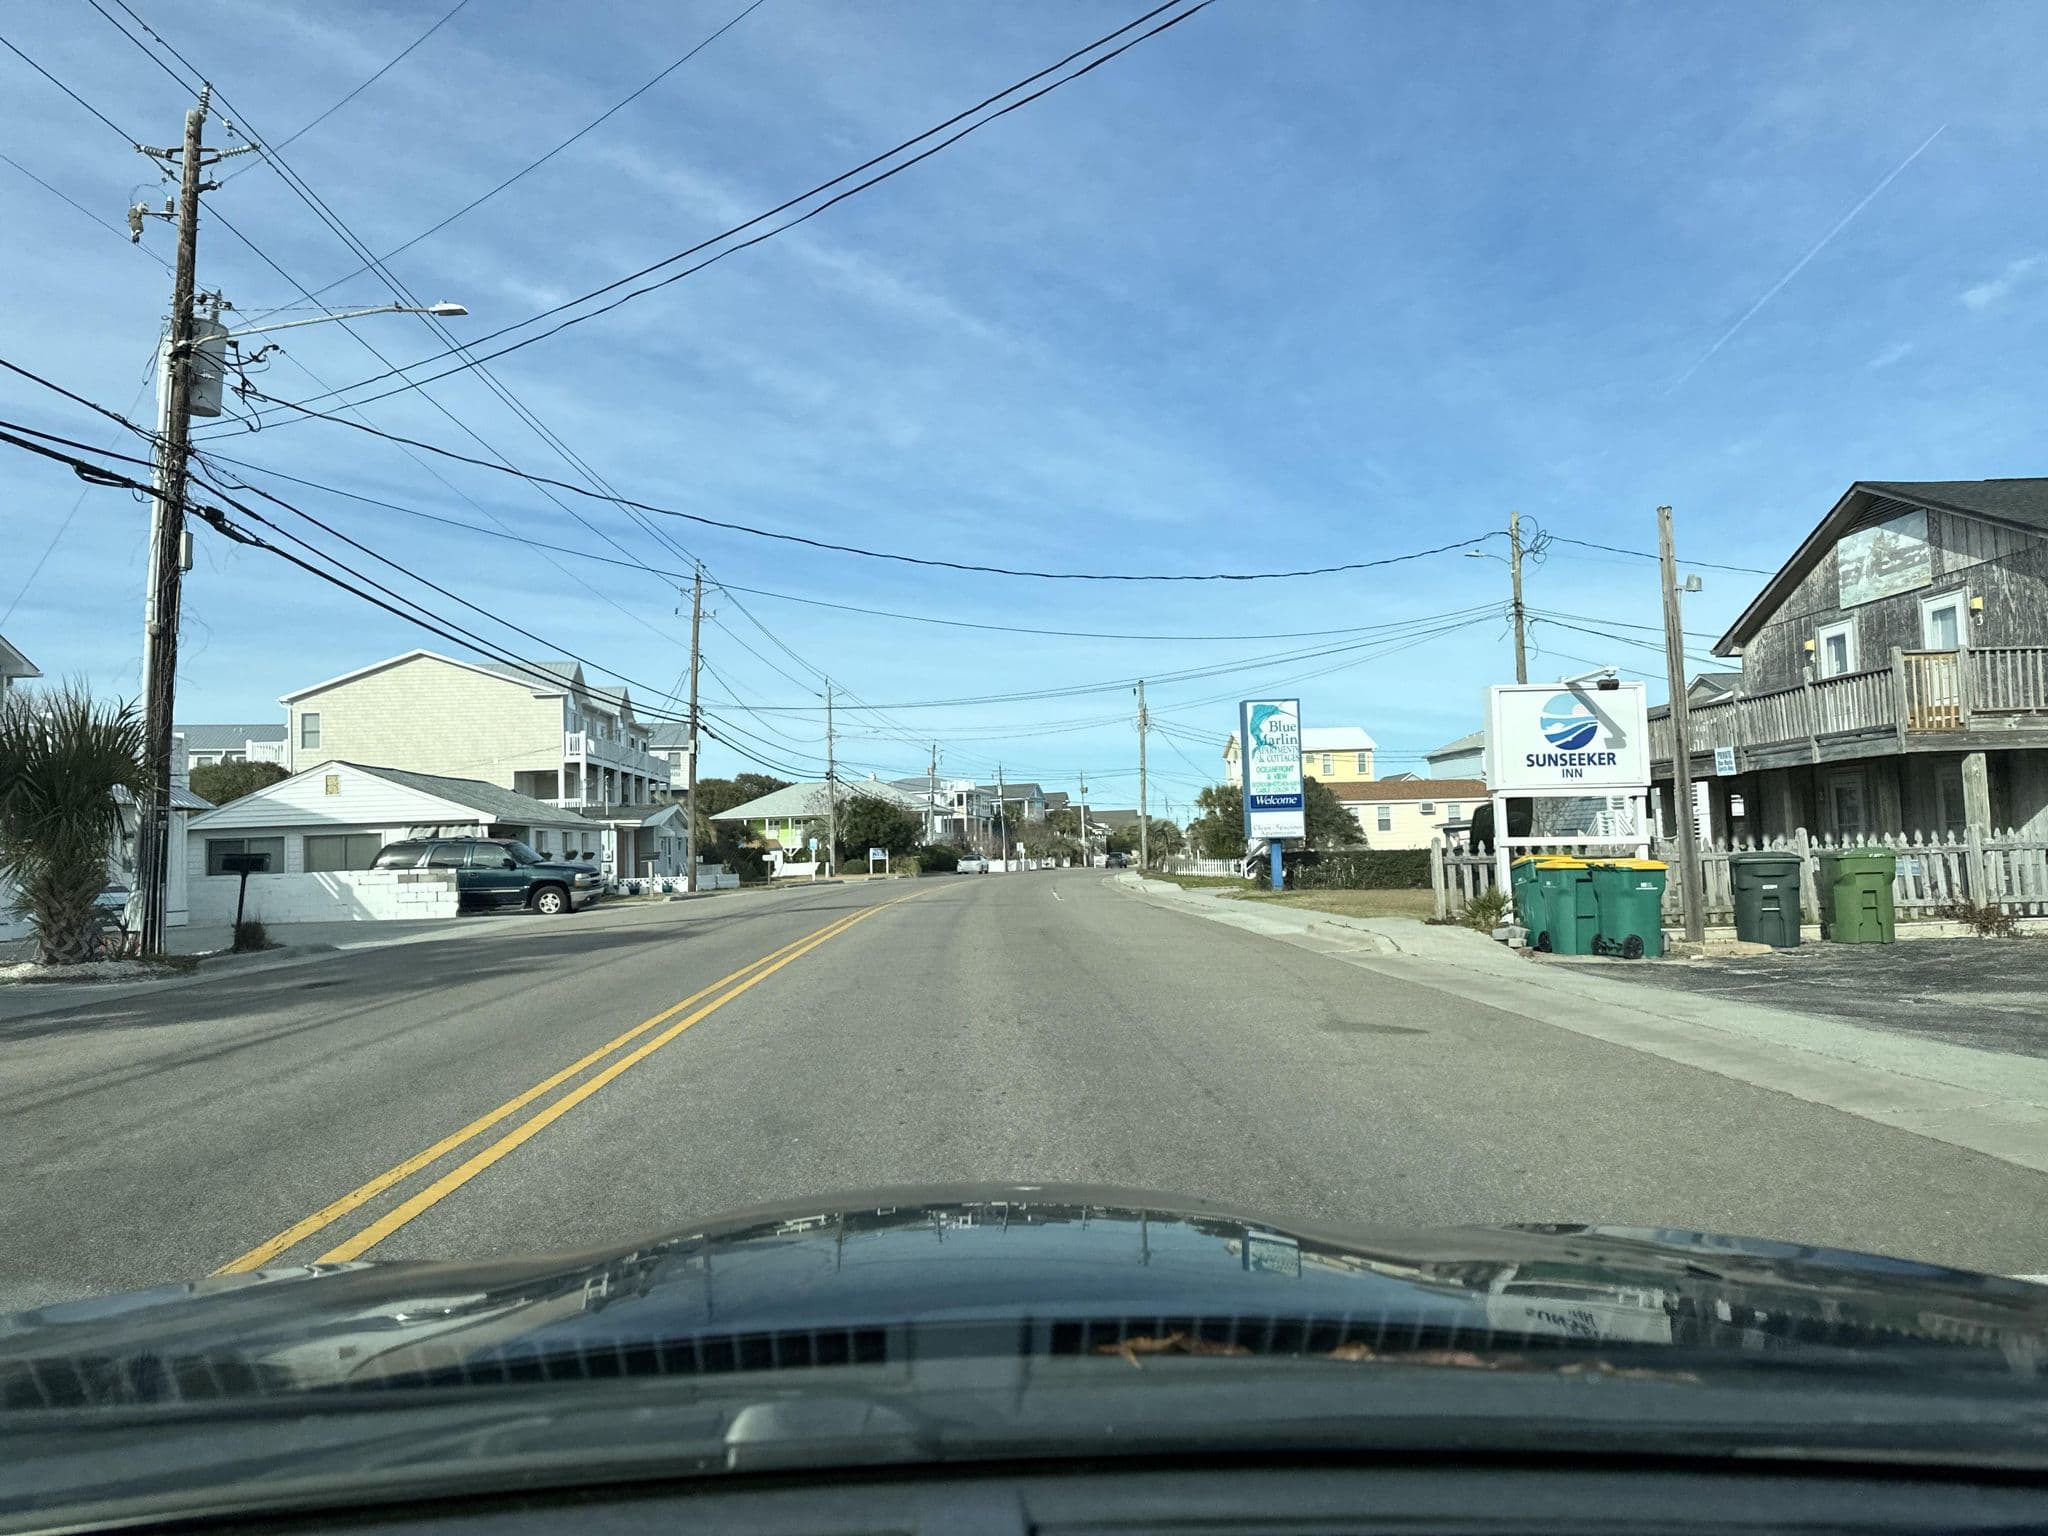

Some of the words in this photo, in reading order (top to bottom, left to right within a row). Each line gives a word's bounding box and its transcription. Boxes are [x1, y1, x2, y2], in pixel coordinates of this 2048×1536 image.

[1976, 614, 1984, 626] 3
[1269, 720, 1297, 733] Blue
[1256, 733, 1299, 746] Marlin
[1526, 752, 1617, 768] SUNSEEKER
[1562, 768, 1583, 778] INN
[1256, 795, 1298, 805] Welcome
